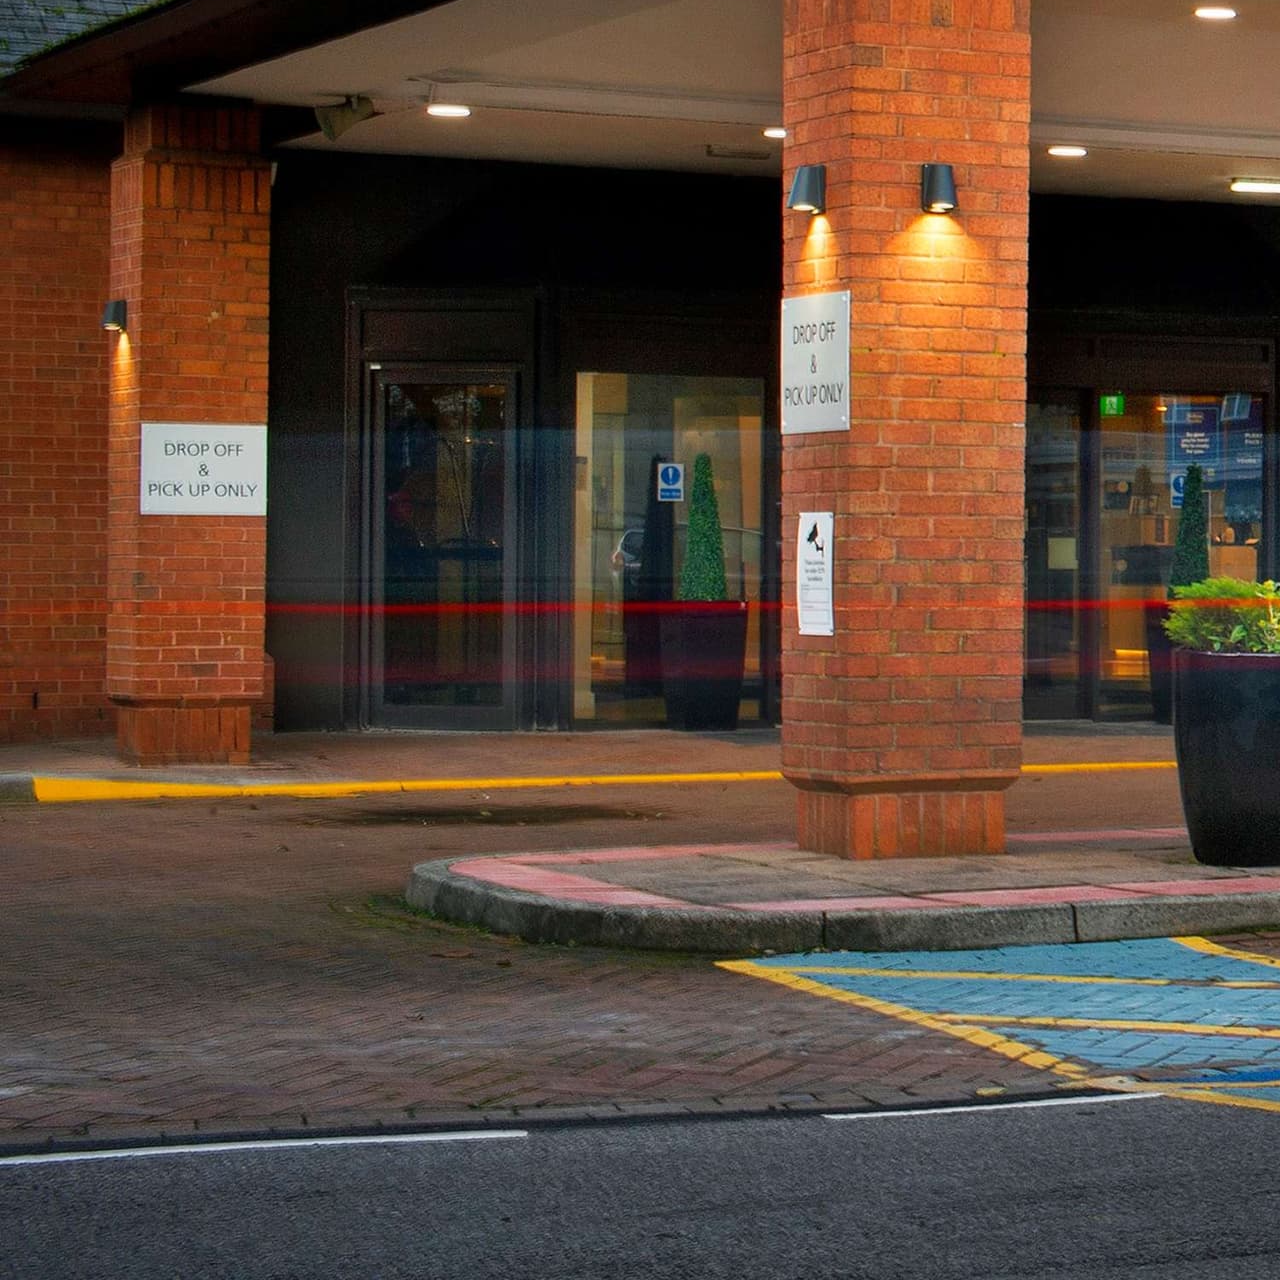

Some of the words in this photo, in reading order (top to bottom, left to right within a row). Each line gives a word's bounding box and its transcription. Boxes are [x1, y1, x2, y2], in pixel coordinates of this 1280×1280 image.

[792, 324, 817, 344] DROP
[819, 321, 836, 342] OFF
[810, 354, 817, 374] &
[784, 386, 804, 406] PICK
[805, 385, 817, 405] UP
[819, 383, 843, 403] ONLY
[164, 443, 210, 457] DROP
[214, 444, 245, 457] OFF
[198, 463, 209, 477] &
[148, 483, 184, 497] PICK
[188, 484, 210, 497] UP
[214, 484, 258, 497] ONLY
